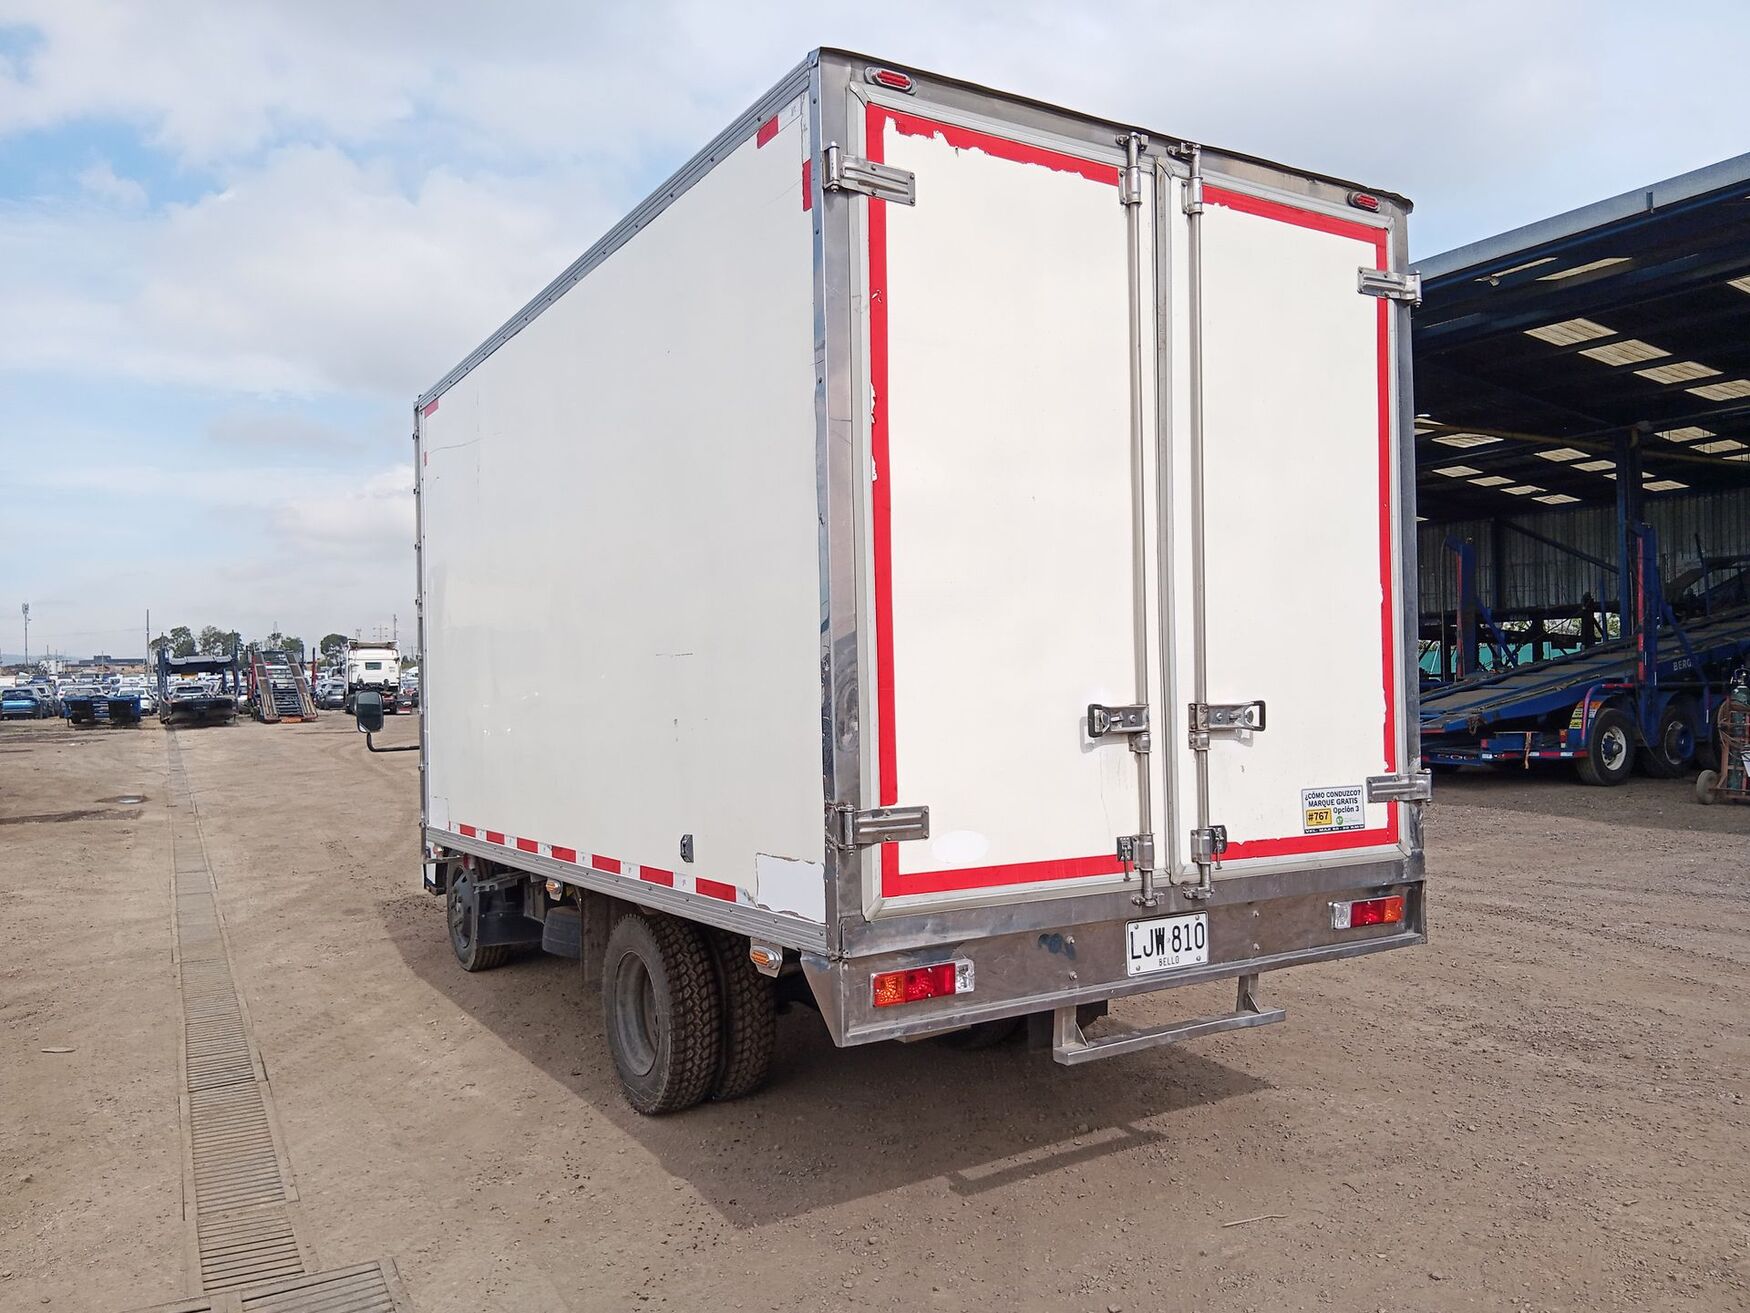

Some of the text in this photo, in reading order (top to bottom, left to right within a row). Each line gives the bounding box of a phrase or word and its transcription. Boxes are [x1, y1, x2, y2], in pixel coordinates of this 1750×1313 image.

[1304, 790, 1361, 801] ¿CÓMO CONDUZCO?
[1308, 797, 1358, 808] MARQUE GRATIS
[1308, 811, 1329, 821] #767
[1333, 806, 1355, 815] Opción
[1130, 922, 1205, 960] LJW 810
[1159, 956, 1180, 967] BELLO
